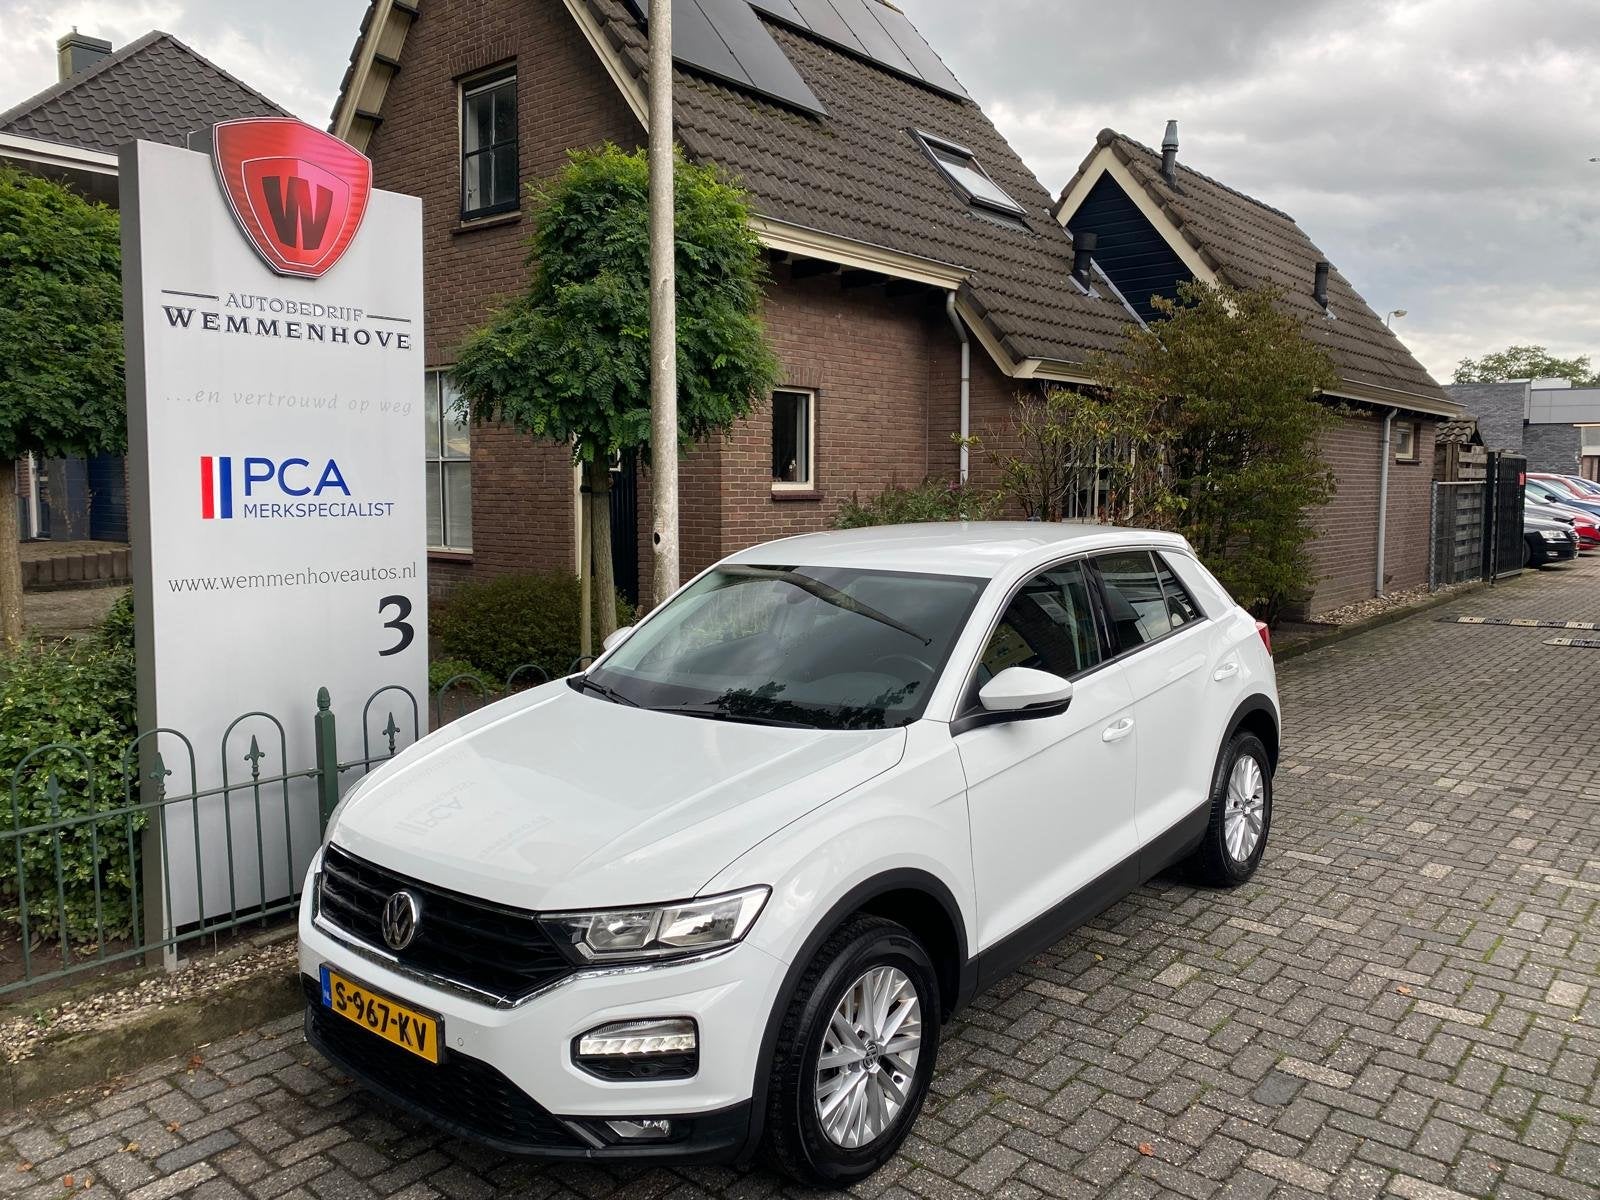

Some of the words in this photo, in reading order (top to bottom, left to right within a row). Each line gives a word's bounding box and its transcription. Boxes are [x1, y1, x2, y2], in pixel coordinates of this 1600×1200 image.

[261, 175, 334, 250] W
[225, 292, 364, 322] AUTOBEDRIJF
[162, 304, 412, 351] WEMMENHOVE
[232, 391, 338, 410] vertrouwd
[348, 398, 369, 414] op
[379, 400, 412, 416] weg
[243, 457, 352, 497] PCA
[243, 502, 395, 519] MERKSPECIALIST
[168, 561, 417, 593] www.wemmenhoveautos.nl
[378, 594, 415, 657] 3
[335, 981, 427, 1051] S-967-KV
